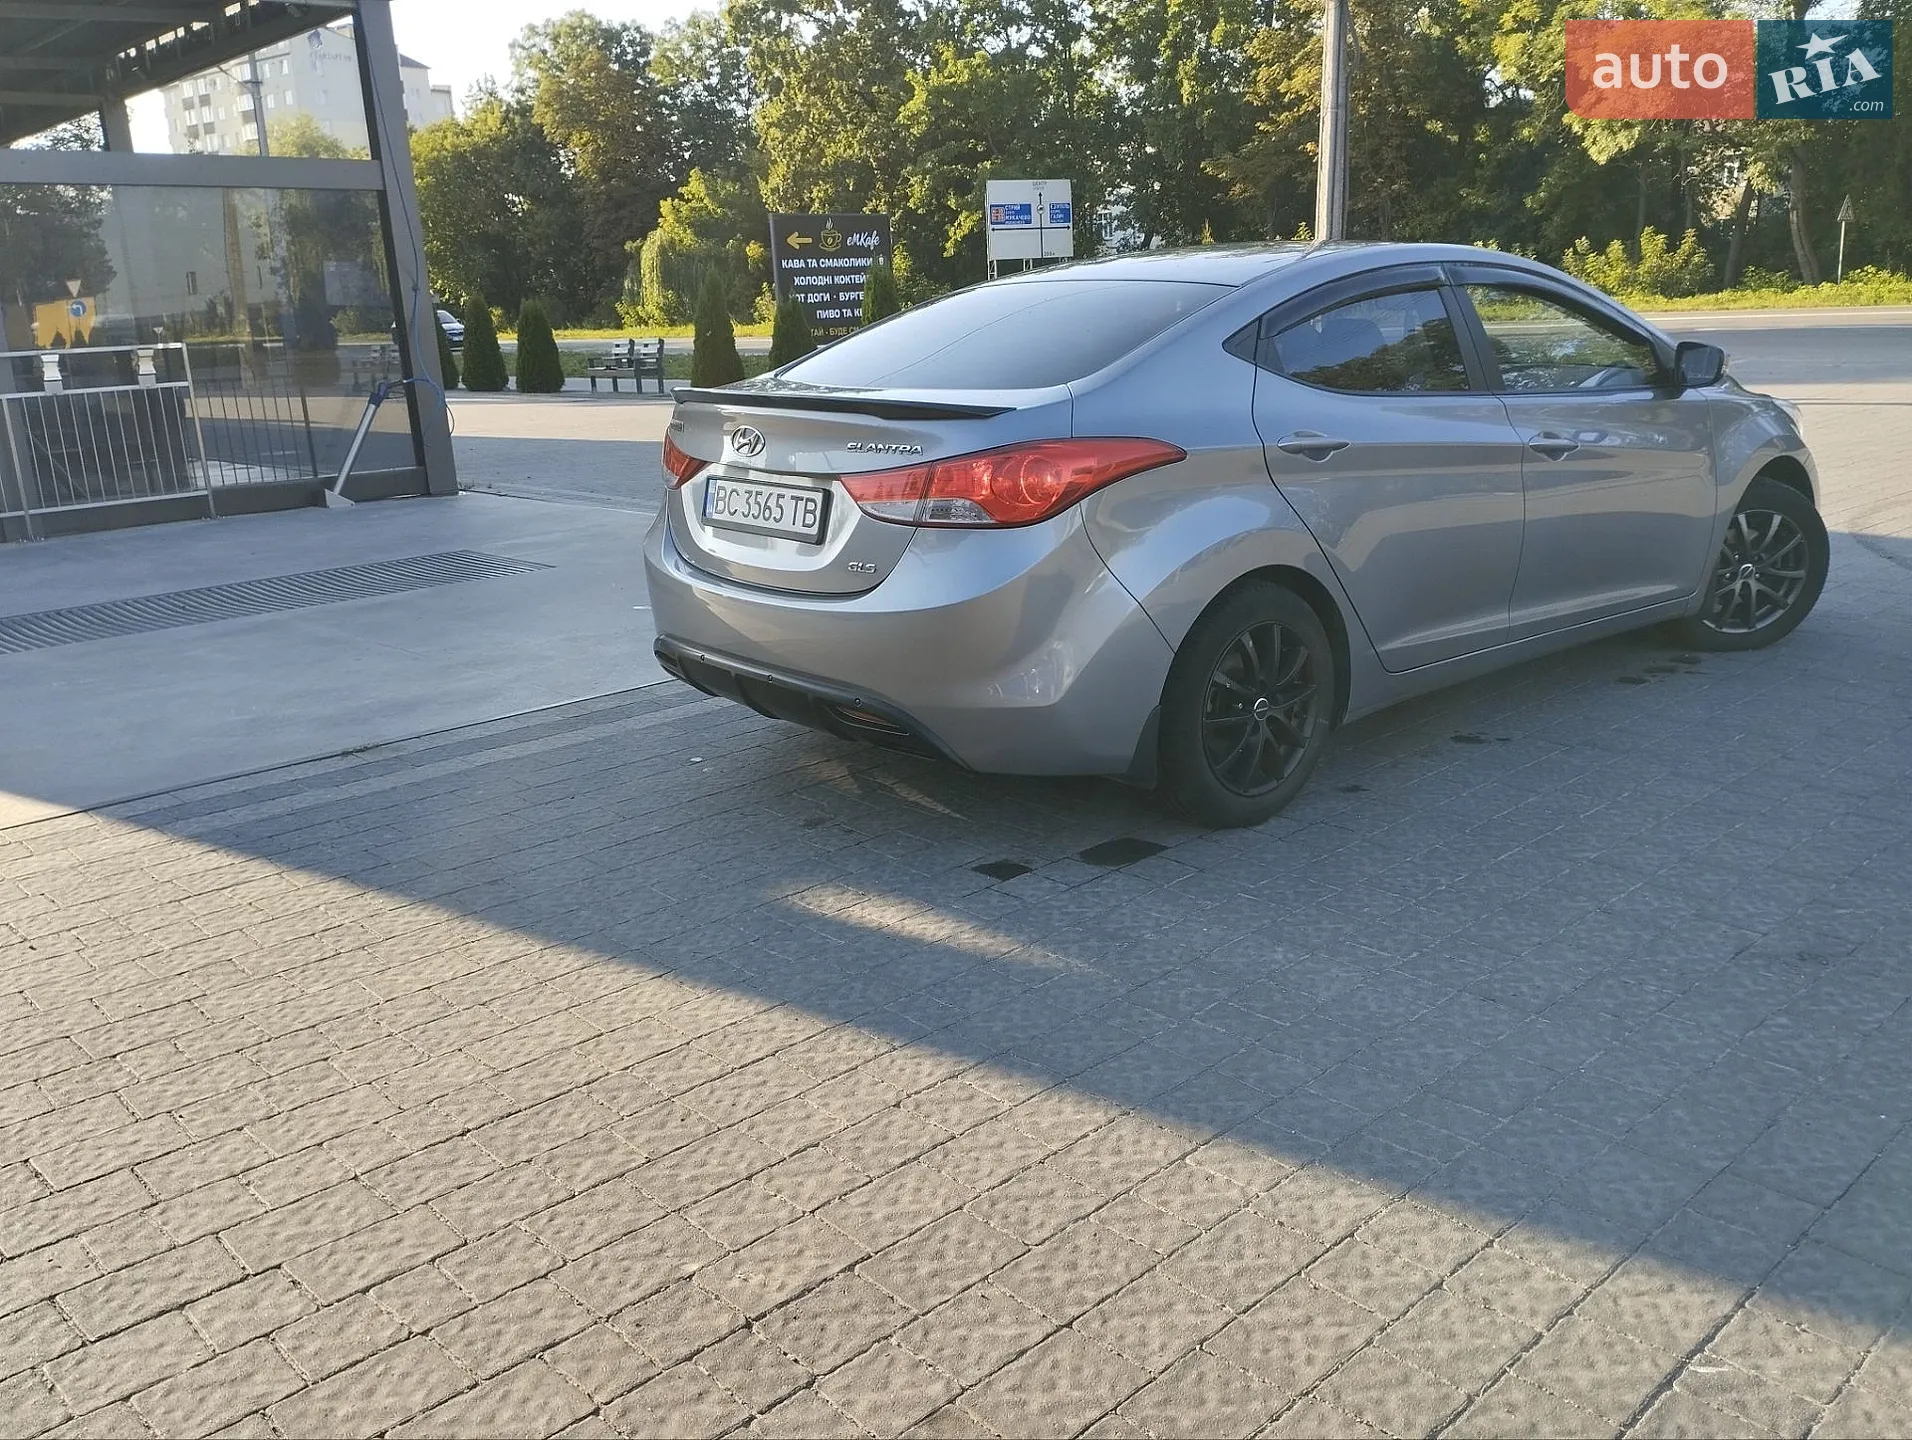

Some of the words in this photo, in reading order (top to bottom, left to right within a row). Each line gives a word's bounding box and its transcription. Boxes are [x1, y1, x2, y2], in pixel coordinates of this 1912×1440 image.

[782, 259, 805, 269] КАВА
[807, 259, 818, 268] ТА
[820, 257, 873, 268] СМАКОЛИКИ
[794, 275, 832, 286] ХОЛОДНІ
[807, 293, 831, 304] ДОГИ
[839, 291, 865, 302] БУРГЕ
[816, 309, 840, 319] ПИВО
[842, 309, 853, 318] ТА
[829, 327, 848, 336] БУДЕ
[846, 441, 924, 456] ELANTRA
[715, 485, 741, 516] BC
[741, 489, 786, 523] 3565
[790, 495, 818, 528] TB
[847, 561, 877, 574] GLS
